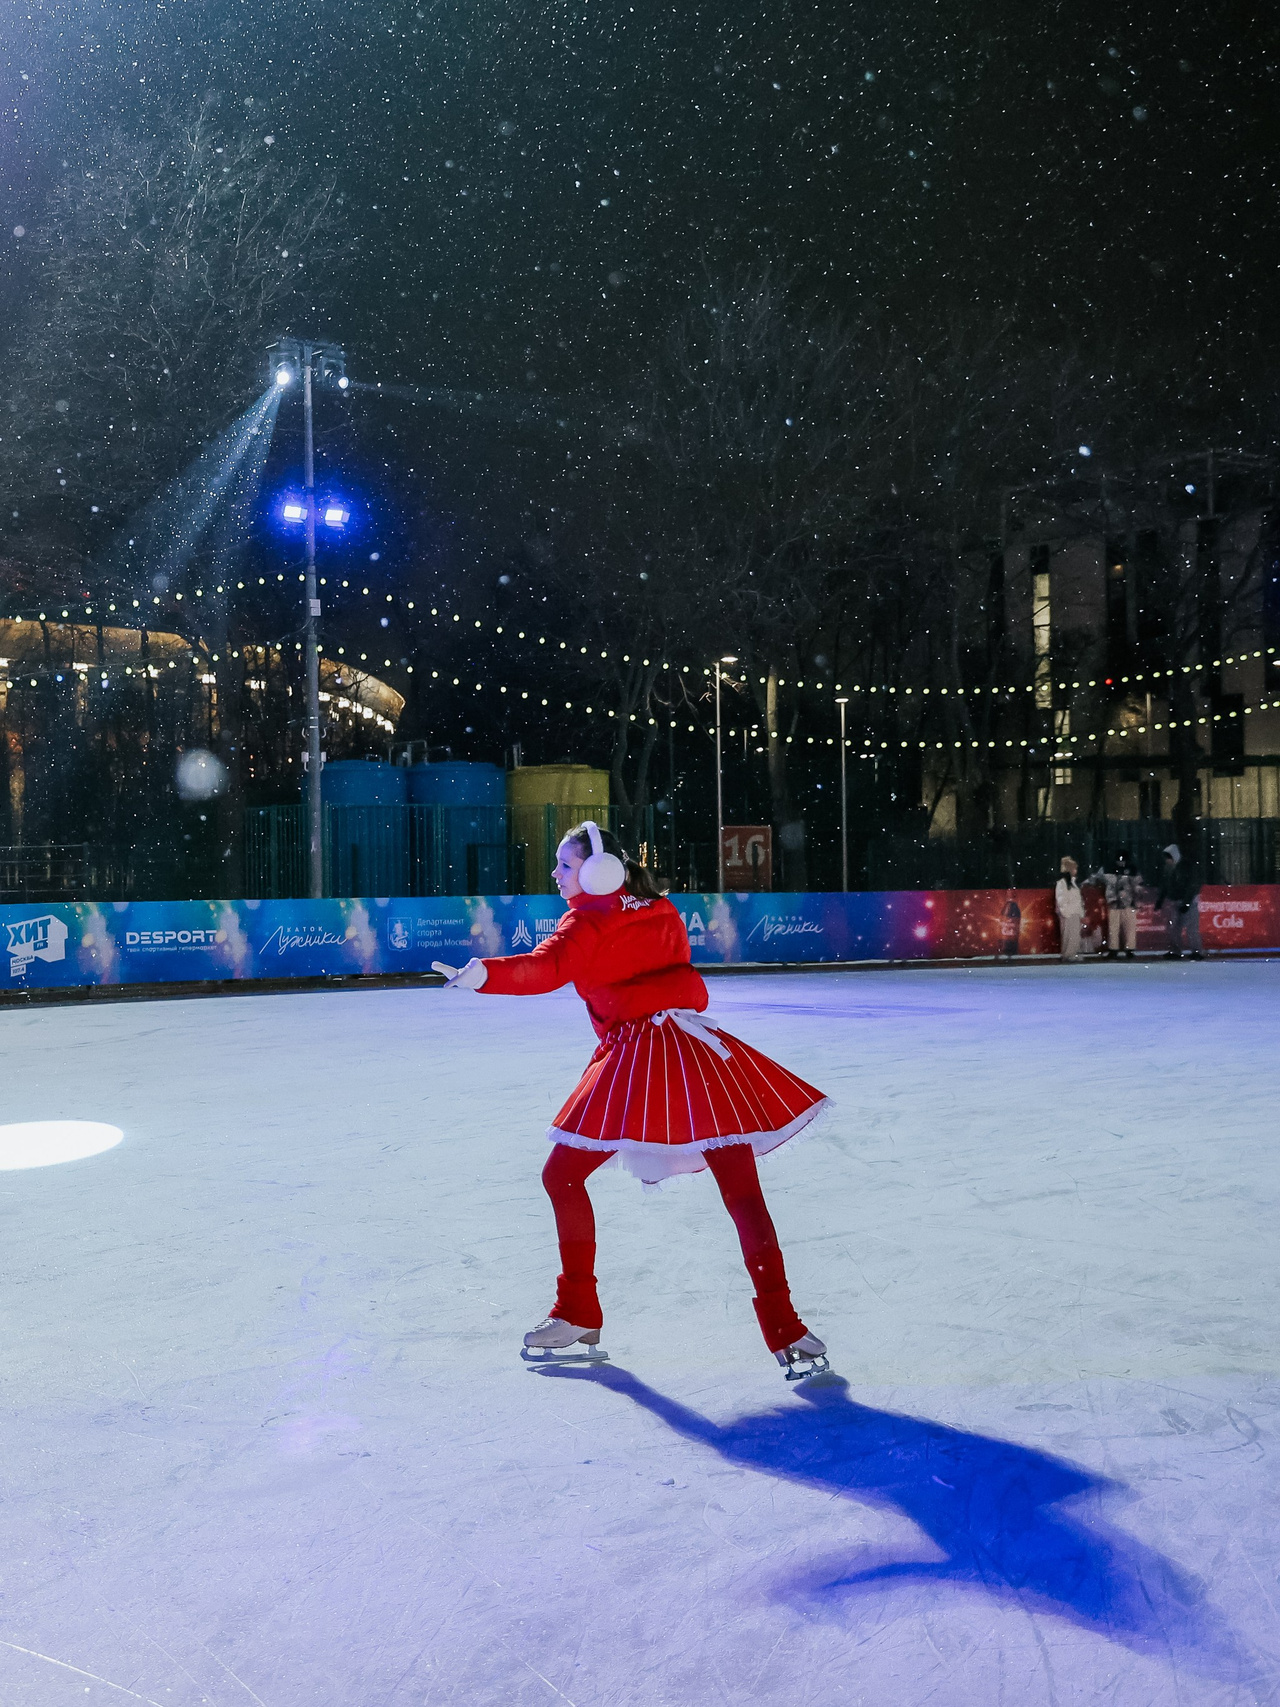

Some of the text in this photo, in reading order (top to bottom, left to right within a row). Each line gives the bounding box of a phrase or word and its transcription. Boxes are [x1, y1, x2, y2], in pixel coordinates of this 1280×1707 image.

[724, 834, 766, 867] 16
[417, 918, 464, 927] Департамент
[746, 914, 824, 941] Лужники
[1212, 914, 1244, 928] Cola
[10, 917, 51, 947] ХИТ
[126, 930, 217, 945] DESPORT
[259, 925, 348, 955] Лужники
[417, 939, 472, 948] города Москвы
